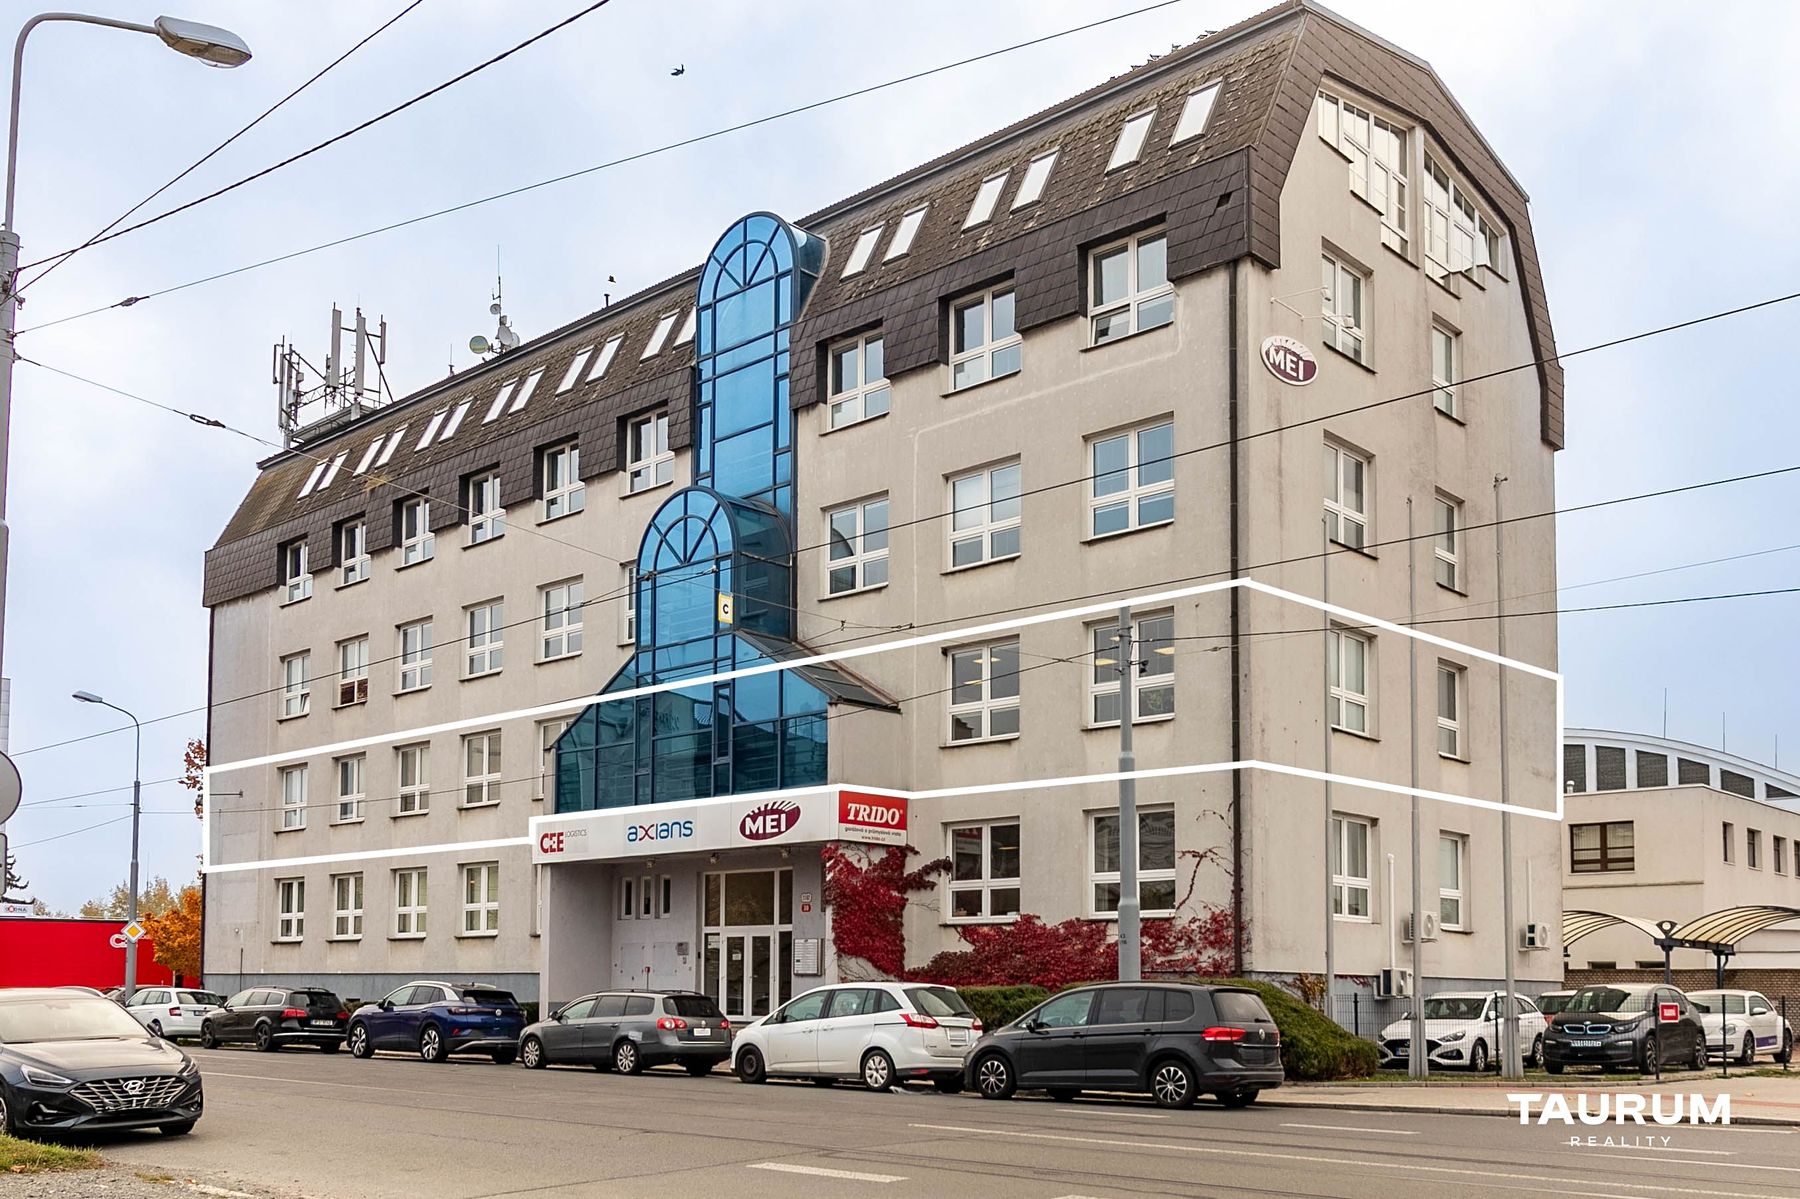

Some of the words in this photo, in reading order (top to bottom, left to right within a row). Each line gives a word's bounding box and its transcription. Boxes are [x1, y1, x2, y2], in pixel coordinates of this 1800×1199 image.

[1269, 346, 1304, 381] MEI
[722, 603, 730, 615] C
[744, 813, 787, 836] MEI
[847, 802, 900, 826] TRIDO
[539, 831, 565, 854] CEE
[565, 828, 588, 838] LOGISTICS
[627, 820, 694, 843] axians
